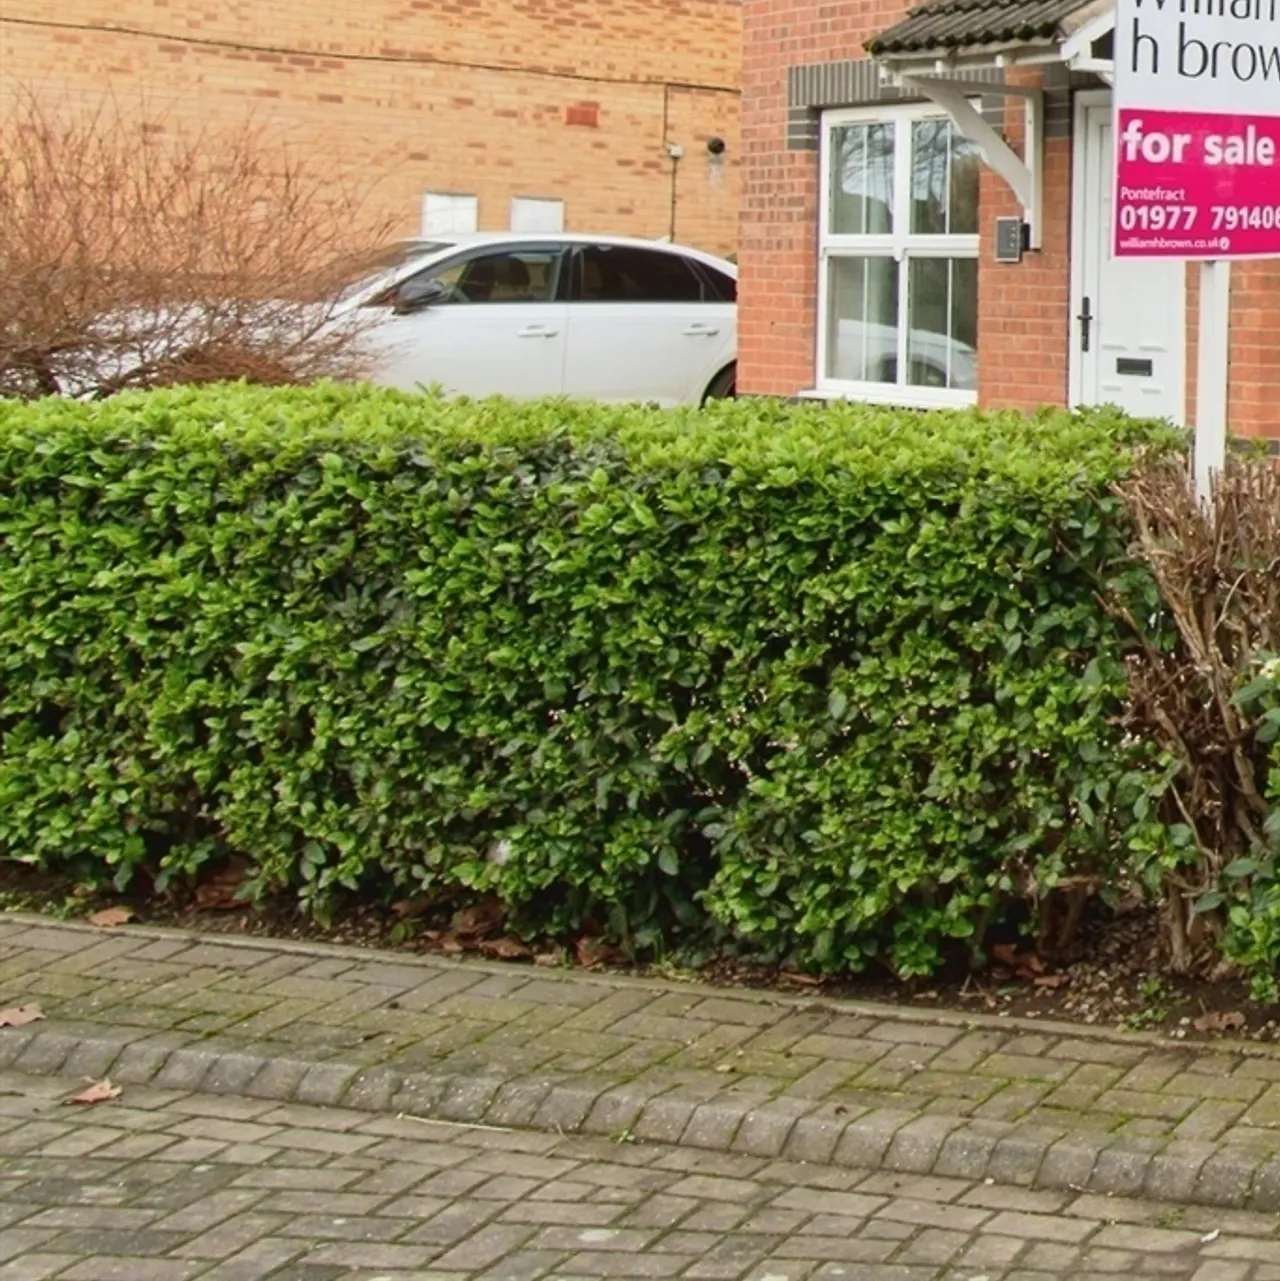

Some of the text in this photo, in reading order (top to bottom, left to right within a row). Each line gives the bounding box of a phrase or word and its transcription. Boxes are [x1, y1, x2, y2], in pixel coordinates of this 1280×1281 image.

[1132, 17, 1159, 74] h
[1123, 118, 1276, 166] for sale
[1120, 186, 1186, 201] Pontefract
[1120, 204, 1198, 231] 01977
